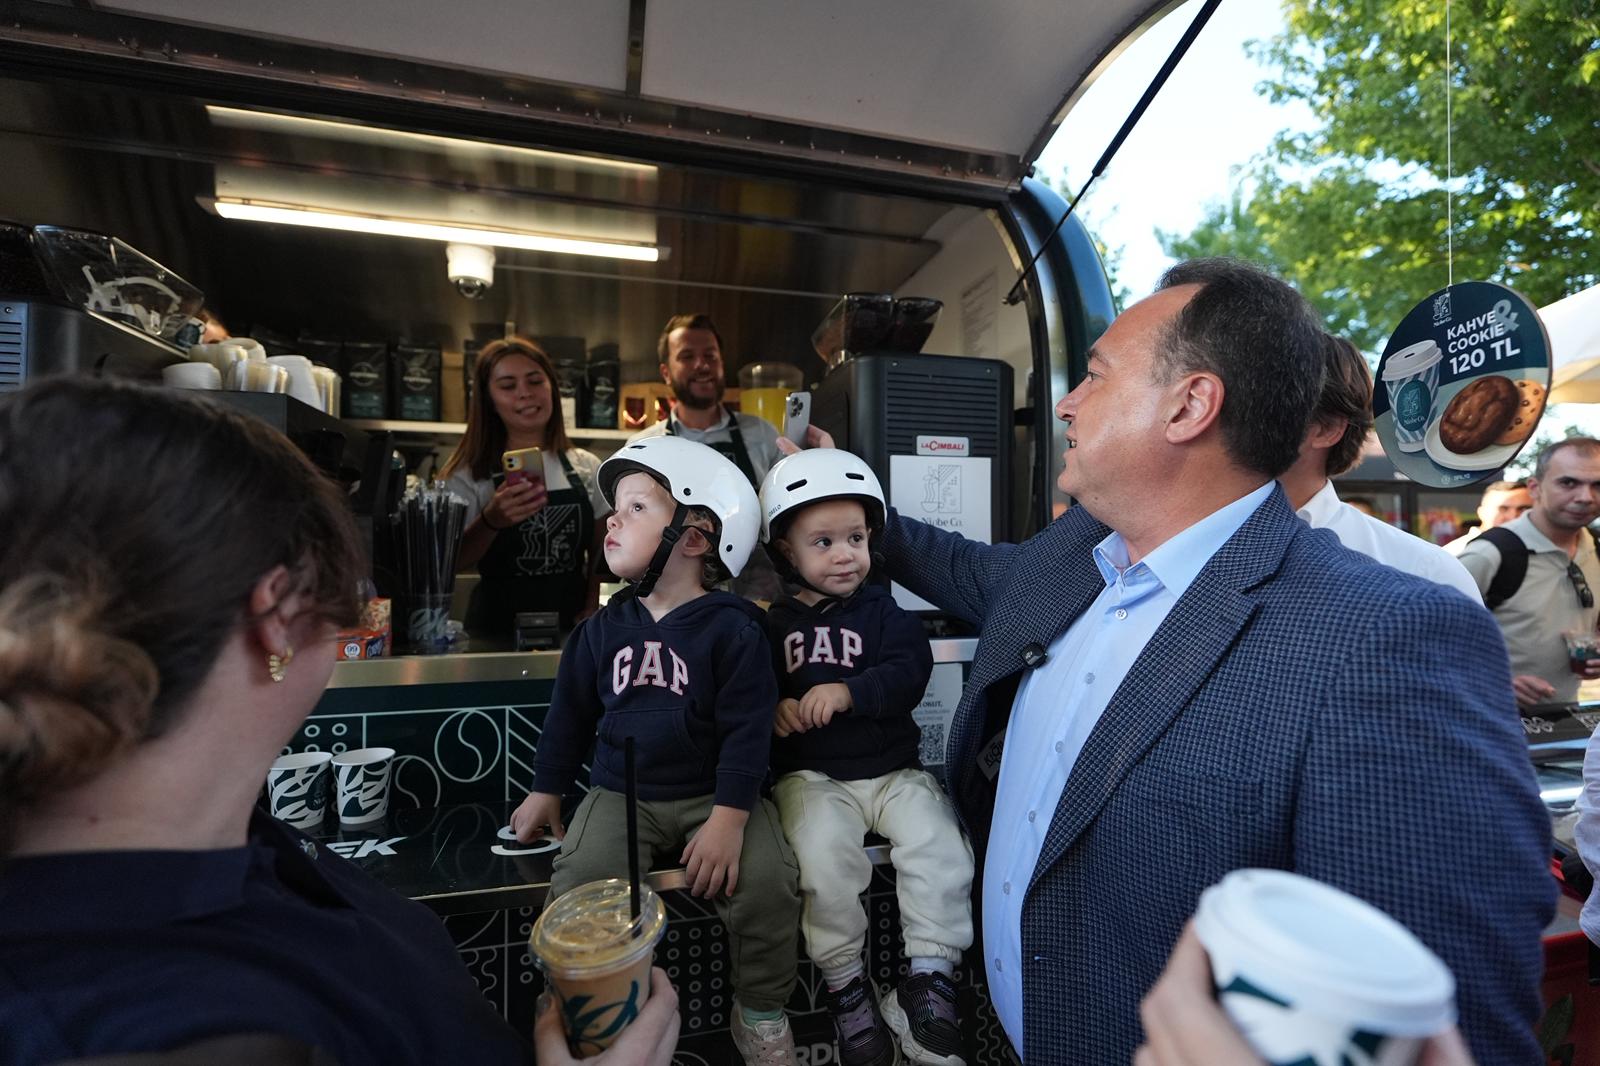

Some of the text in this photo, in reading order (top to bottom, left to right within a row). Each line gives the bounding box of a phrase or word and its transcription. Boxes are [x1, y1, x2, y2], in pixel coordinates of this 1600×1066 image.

[1447, 310, 1497, 340] KAHVE
[1448, 323, 1505, 353] COOKIE
[1449, 337, 1521, 375] 120 TL
[612, 640, 690, 696] GAP
[783, 626, 863, 673] GAP
